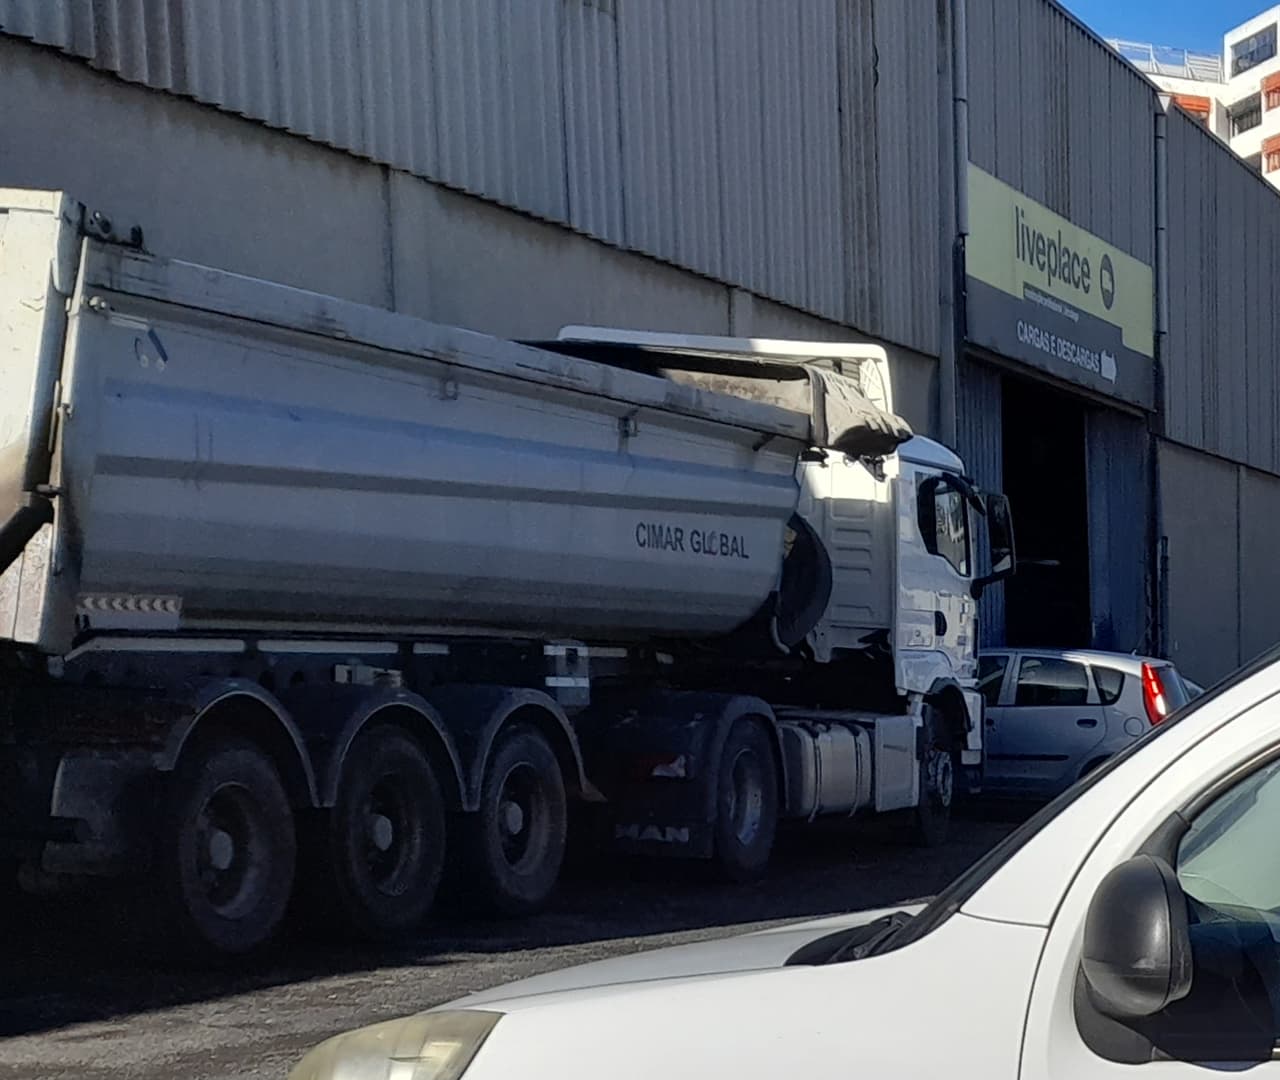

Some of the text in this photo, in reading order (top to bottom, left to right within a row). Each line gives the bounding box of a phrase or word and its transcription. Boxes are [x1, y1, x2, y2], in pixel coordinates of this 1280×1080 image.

[1015, 205, 1091, 294] liveplace
[1017, 319, 1100, 373] CARGAS E DESCARGAS
[635, 522, 749, 559] CIMAR GLOBAL
